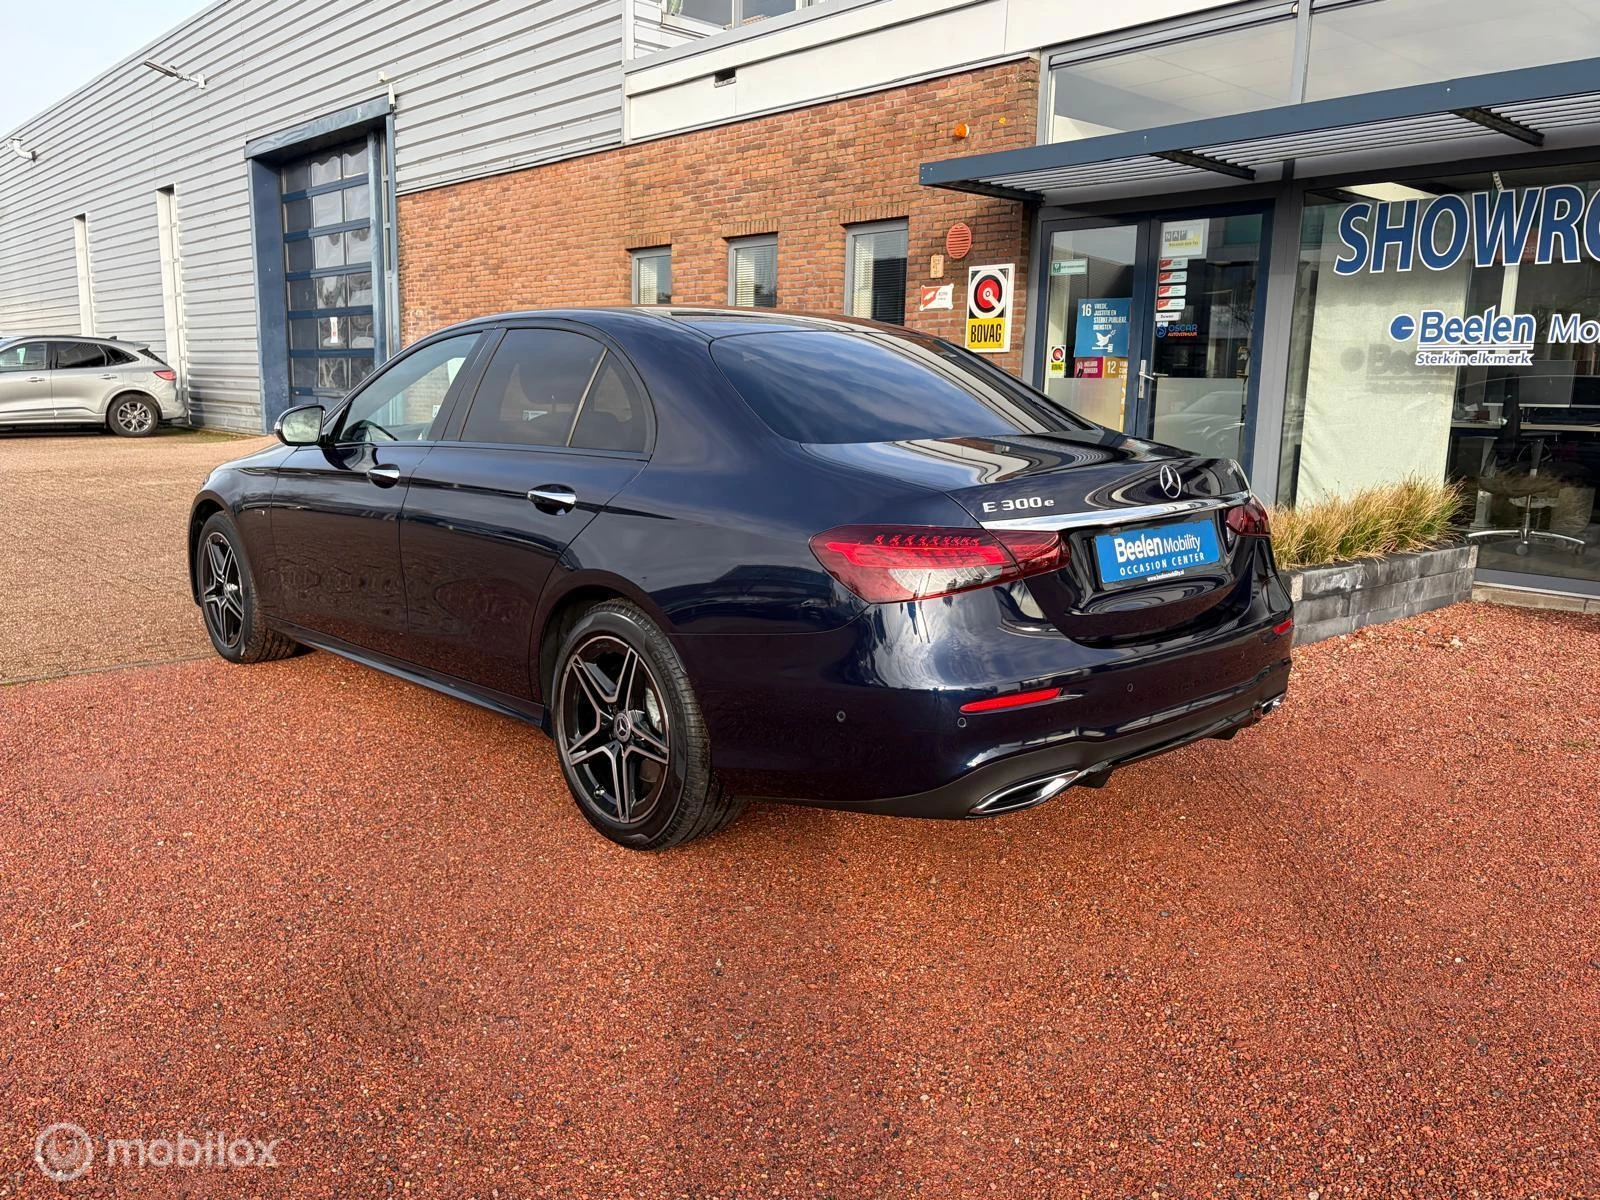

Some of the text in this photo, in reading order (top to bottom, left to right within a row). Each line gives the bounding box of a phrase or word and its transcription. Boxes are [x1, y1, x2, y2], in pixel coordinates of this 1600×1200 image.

[1081, 303, 1092, 317] 16
[1168, 324, 1198, 332] OSCAR
[1417, 305, 1600, 344] Beelen Mo
[970, 323, 1002, 343] BOVAG
[1415, 351, 1533, 366] Sterk in elk merk
[1107, 360, 1117, 374] 12
[982, 501, 998, 513] E
[1113, 533, 1201, 563] Beelen Mobility
[1119, 551, 1206, 576] OCCASION CENTER
